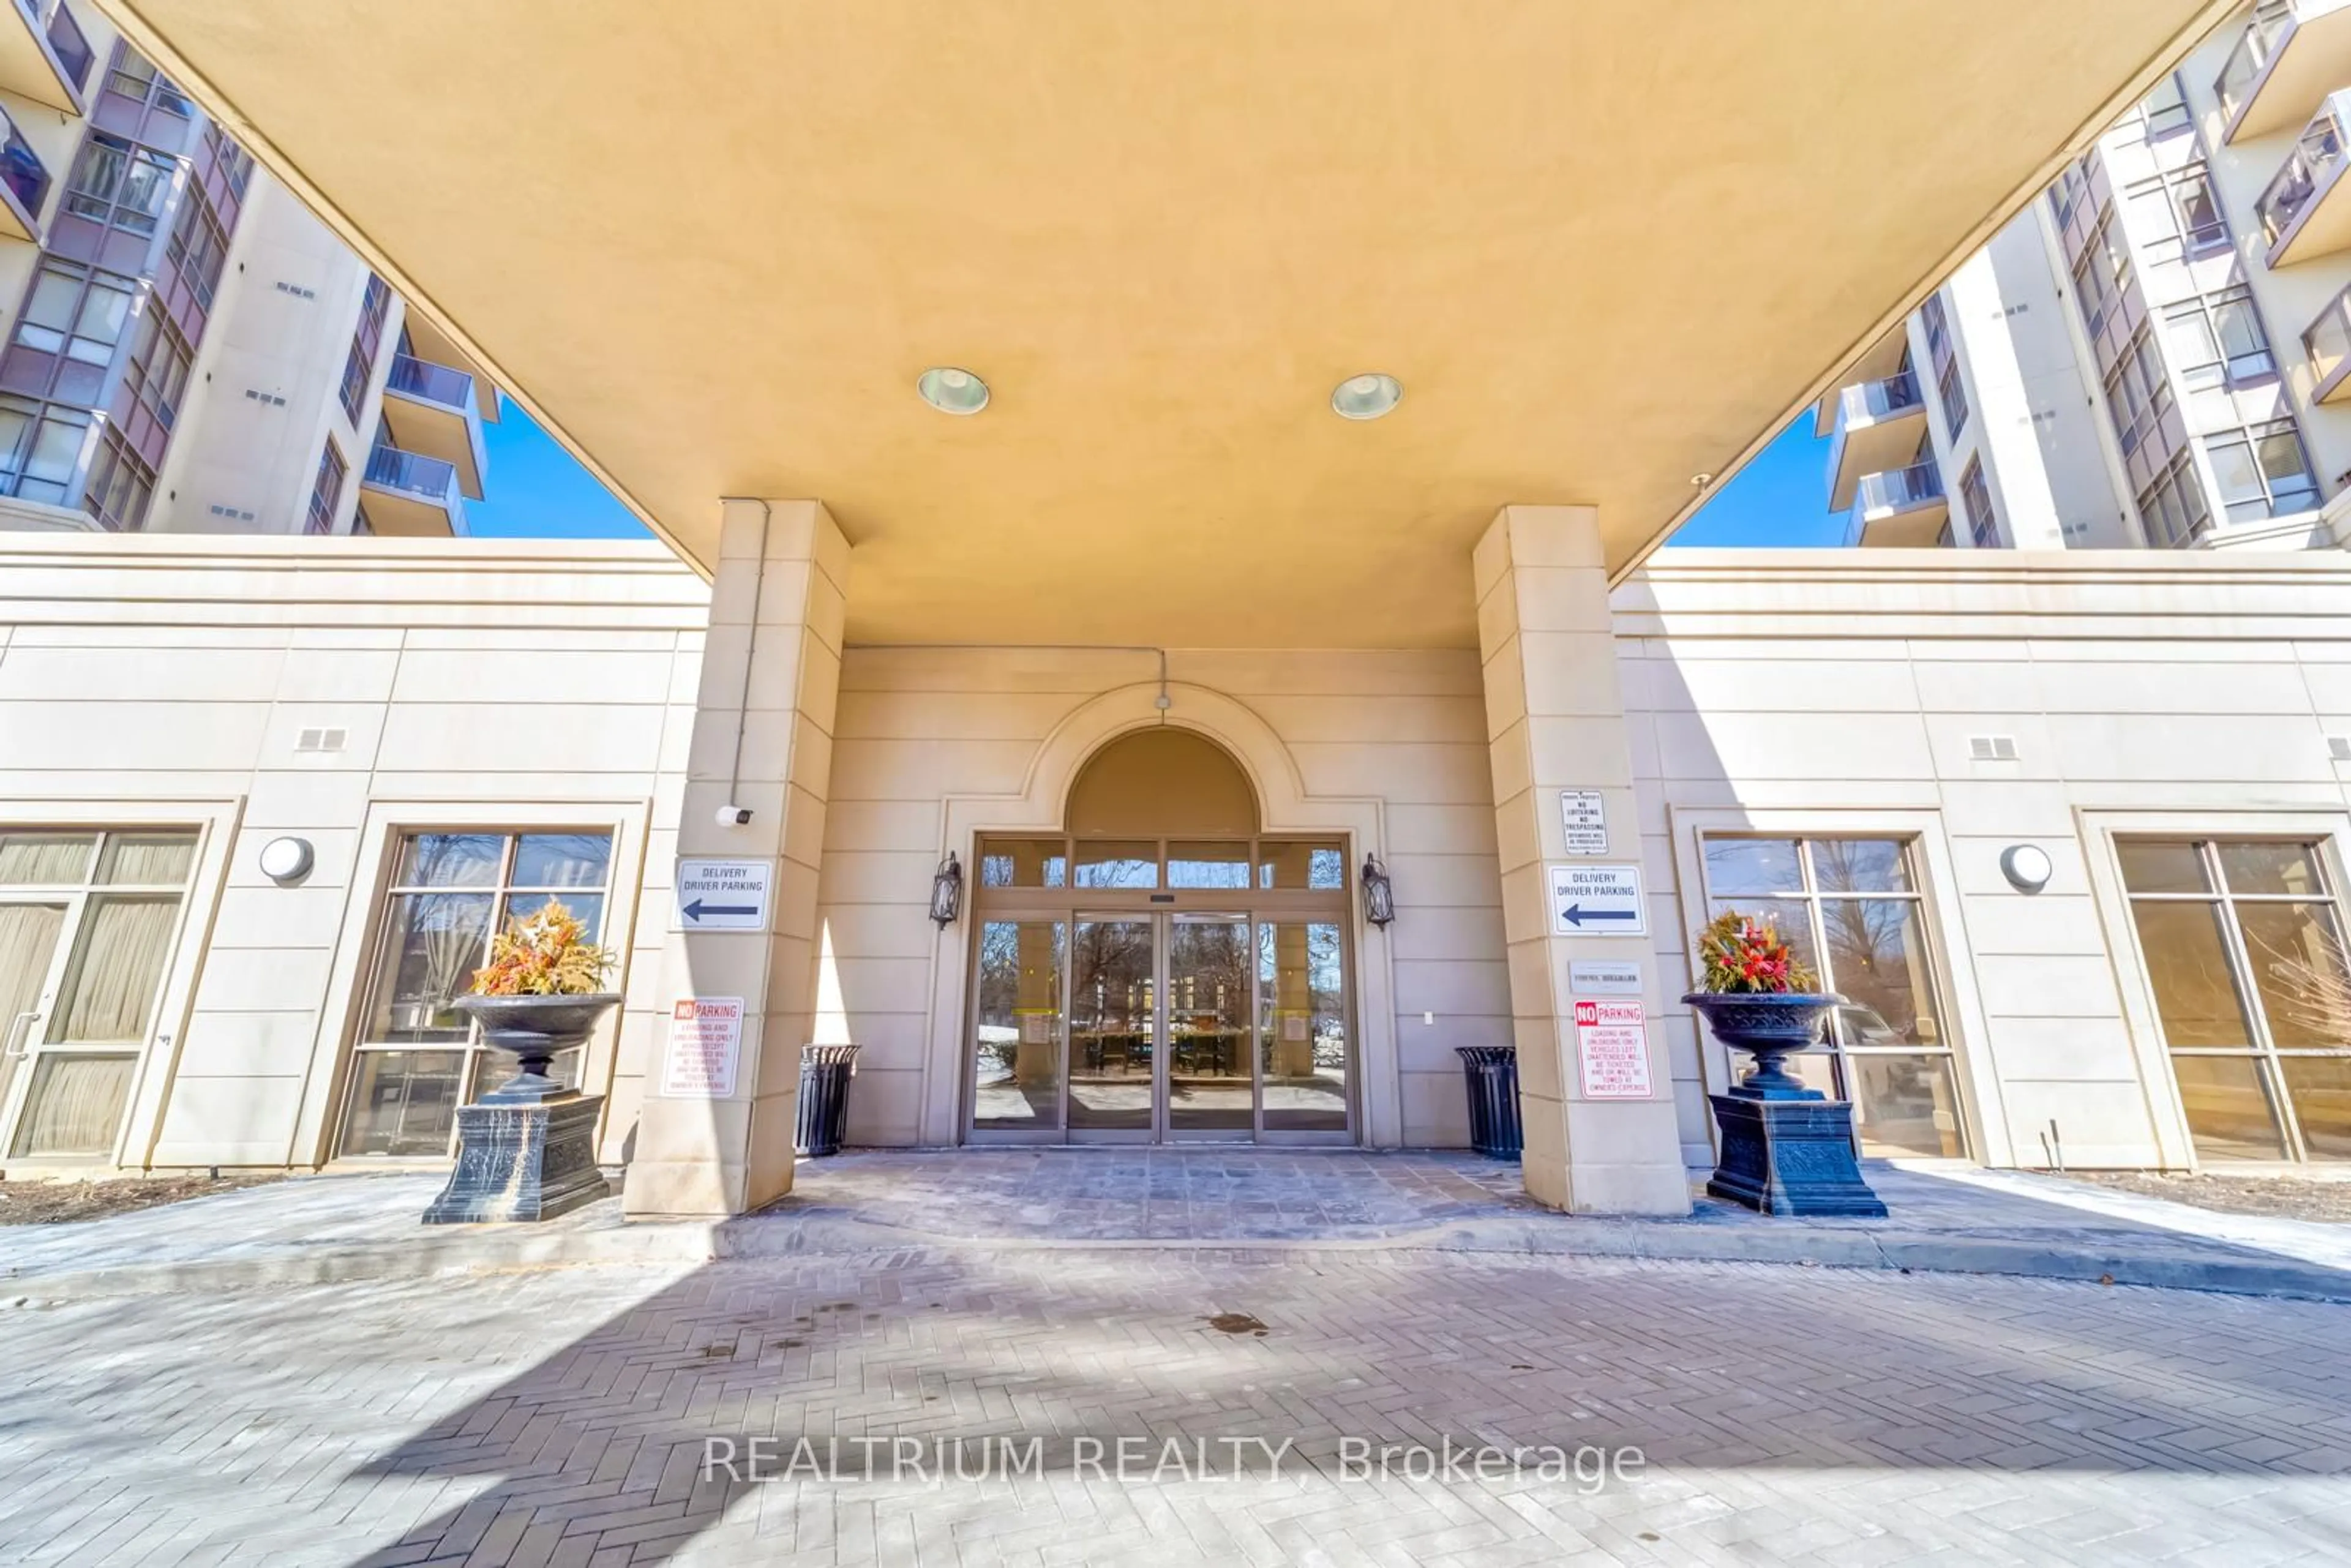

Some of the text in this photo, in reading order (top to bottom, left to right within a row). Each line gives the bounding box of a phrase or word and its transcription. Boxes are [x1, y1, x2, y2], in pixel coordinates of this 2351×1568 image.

[702, 868, 748, 878] DELIVERY
[1572, 873, 1616, 882] DELIVERY
[684, 881, 762, 891] DRIVER PARKING
[1558, 886, 1635, 896] DRIVER PARKING
[677, 1003, 737, 1018] NO PARKING
[1577, 1006, 1640, 1021] NO PARKING
